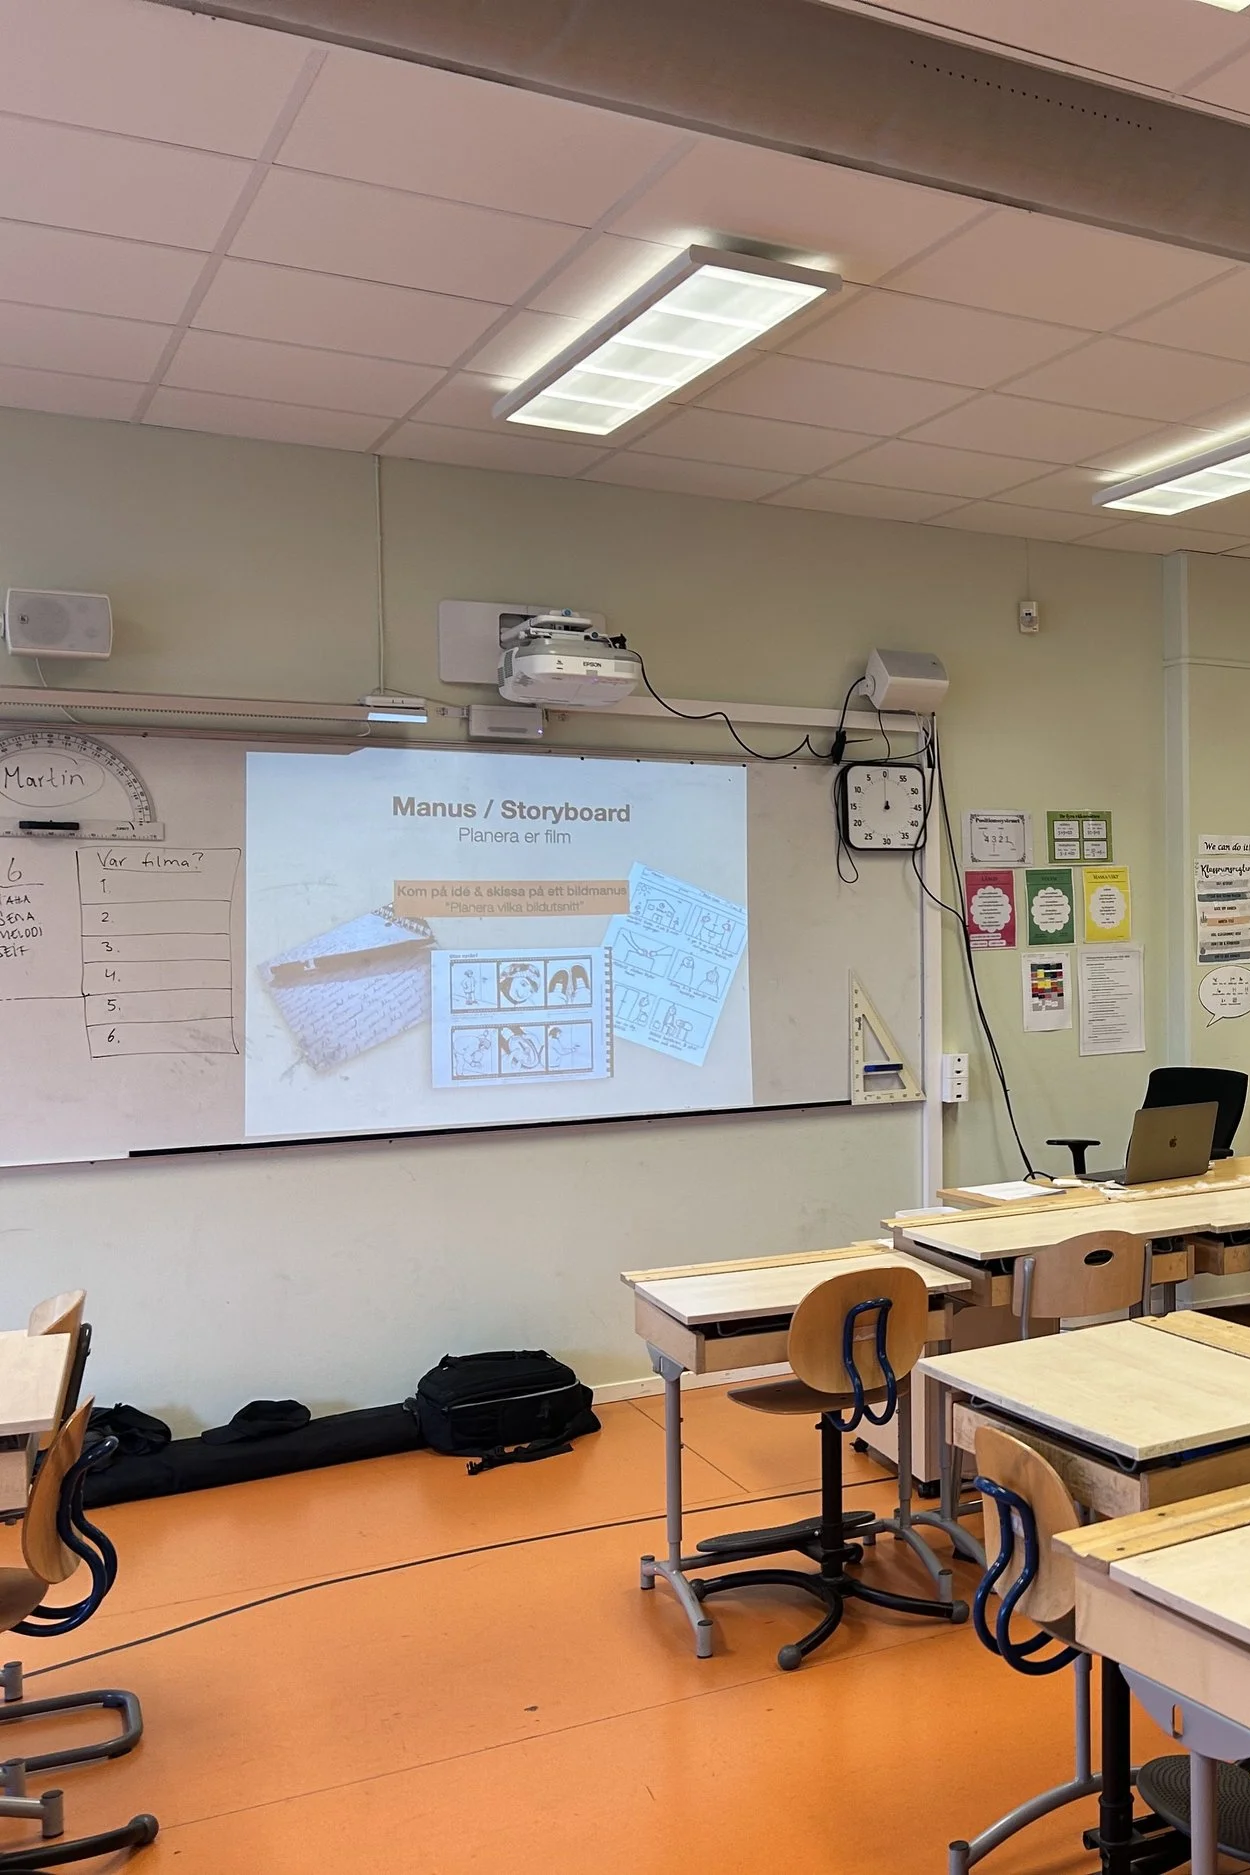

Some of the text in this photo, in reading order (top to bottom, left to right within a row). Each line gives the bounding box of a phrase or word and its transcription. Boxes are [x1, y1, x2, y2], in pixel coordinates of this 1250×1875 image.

[4, 766, 85, 788] Martin
[882, 770, 888, 778] 0
[392, 796, 631, 825] Manus / Storyboard
[458, 826, 572, 844] Planera er film
[901, 832, 909, 840] 35
[1204, 842, 1216, 850] We
[1217, 843, 1230, 851] can
[1232, 842, 1241, 851] do
[97, 851, 204, 870] Var filma?
[7, 857, 22, 882] 6
[397, 885, 627, 899] Kom på idé & skissa på ett bildmanus
[497, 902, 523, 912] vilka
[101, 912, 114, 924] 2.
[102, 942, 120, 953] 3.
[105, 968, 121, 982] 4.
[107, 999, 121, 1012] 5.
[107, 1028, 120, 1043] 6.
